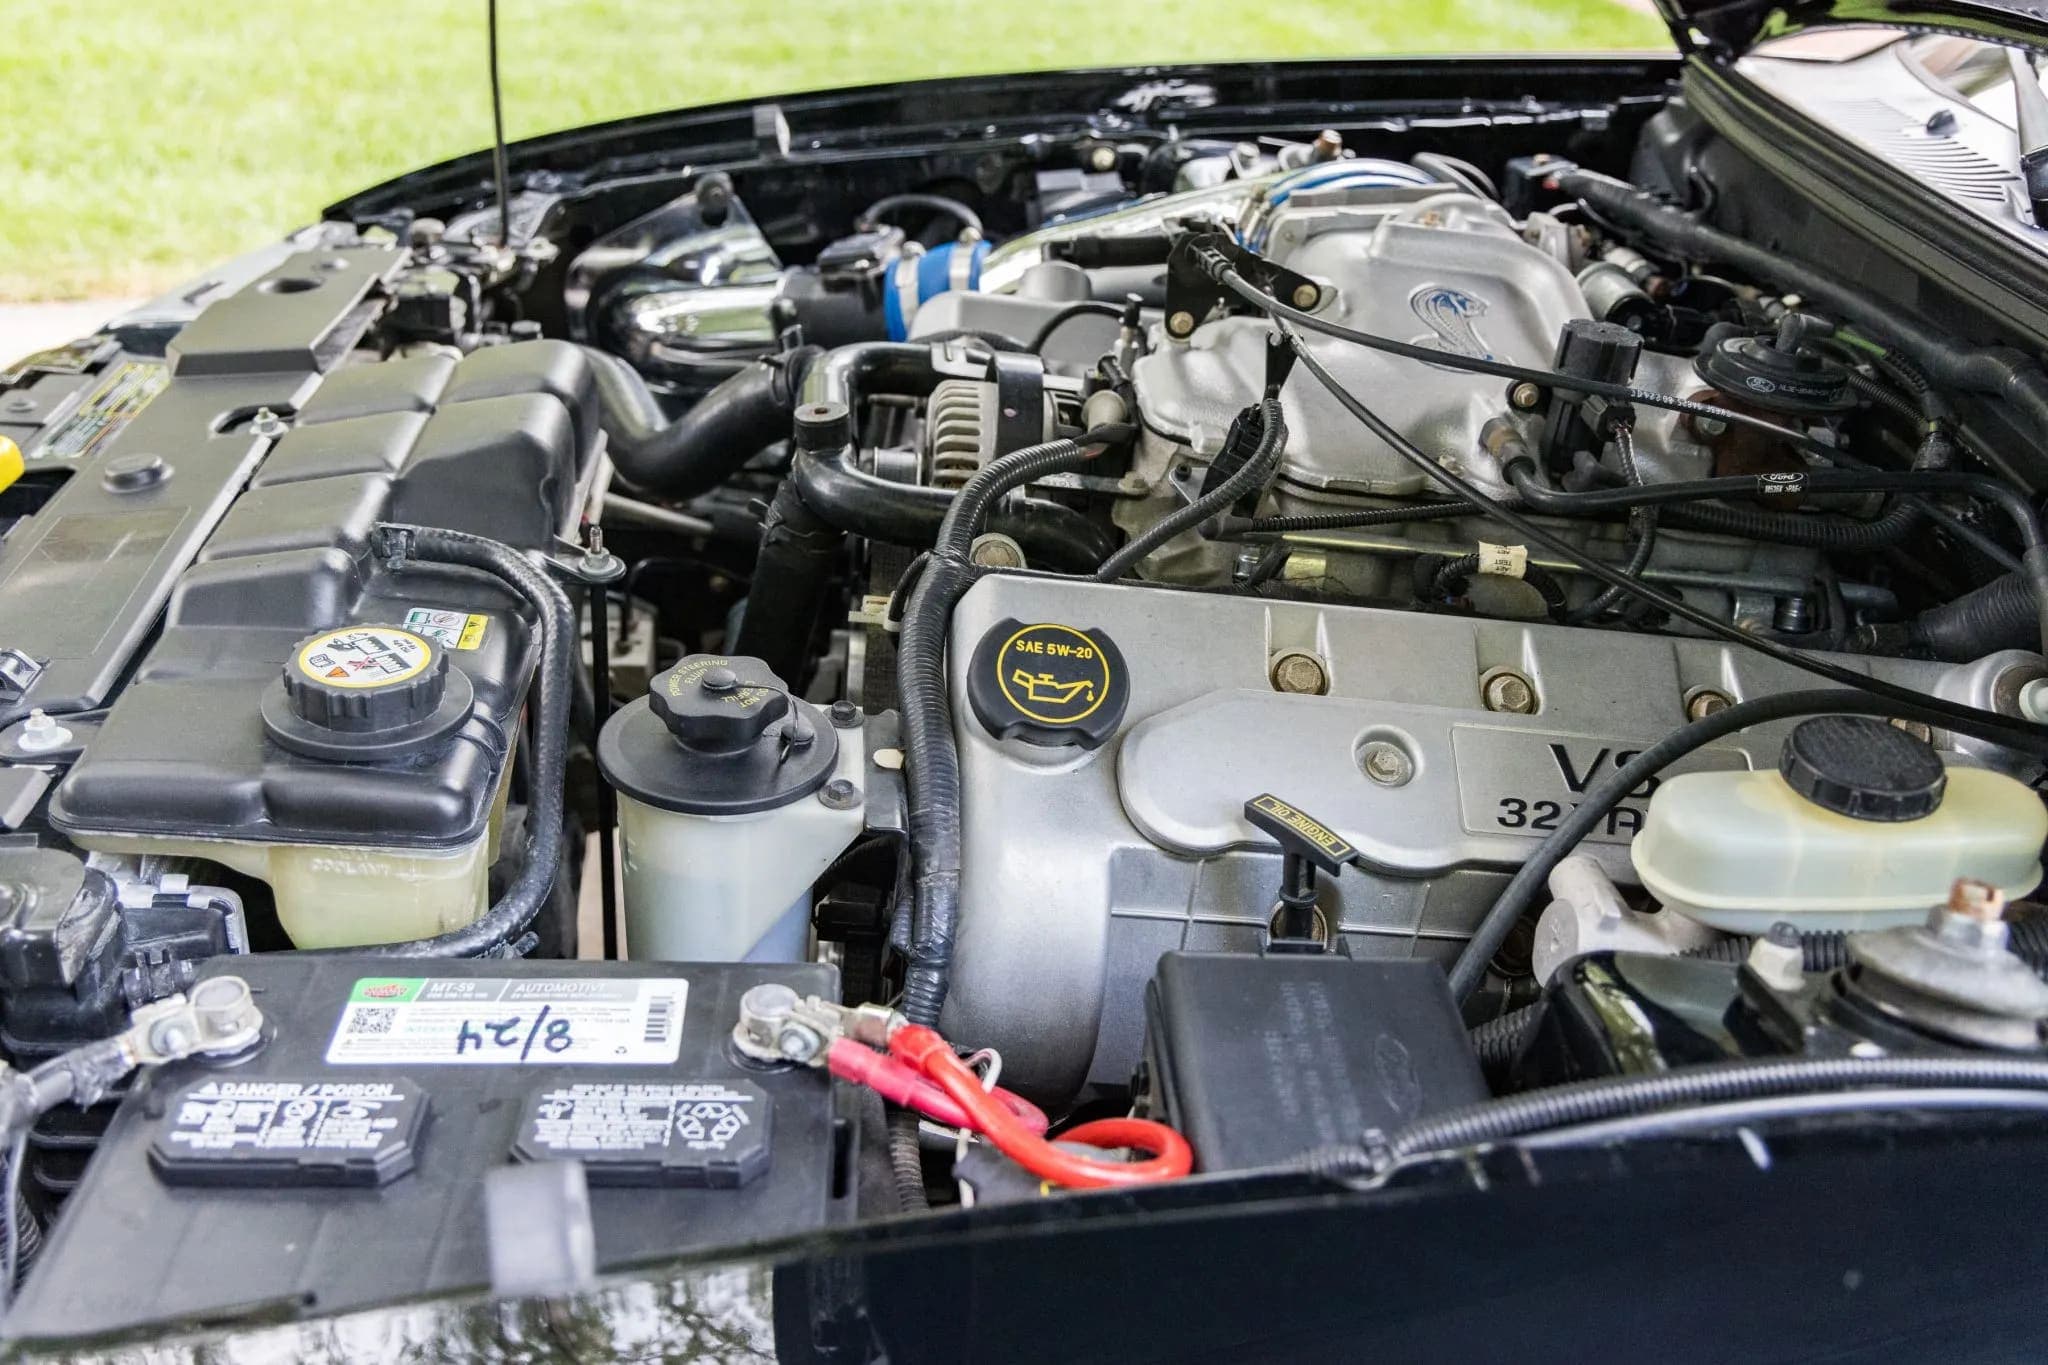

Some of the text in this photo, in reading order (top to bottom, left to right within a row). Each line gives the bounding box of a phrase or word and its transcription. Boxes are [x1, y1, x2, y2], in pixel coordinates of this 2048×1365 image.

[1015, 639, 1093, 660] SAE 5W-20
[1269, 802, 1338, 847] ENGINE OIL
[1496, 797, 1562, 831] 32
[456, 1004, 573, 1061] 8/24
[220, 1082, 303, 1097] DANGER
[318, 1083, 395, 1097] POISON
